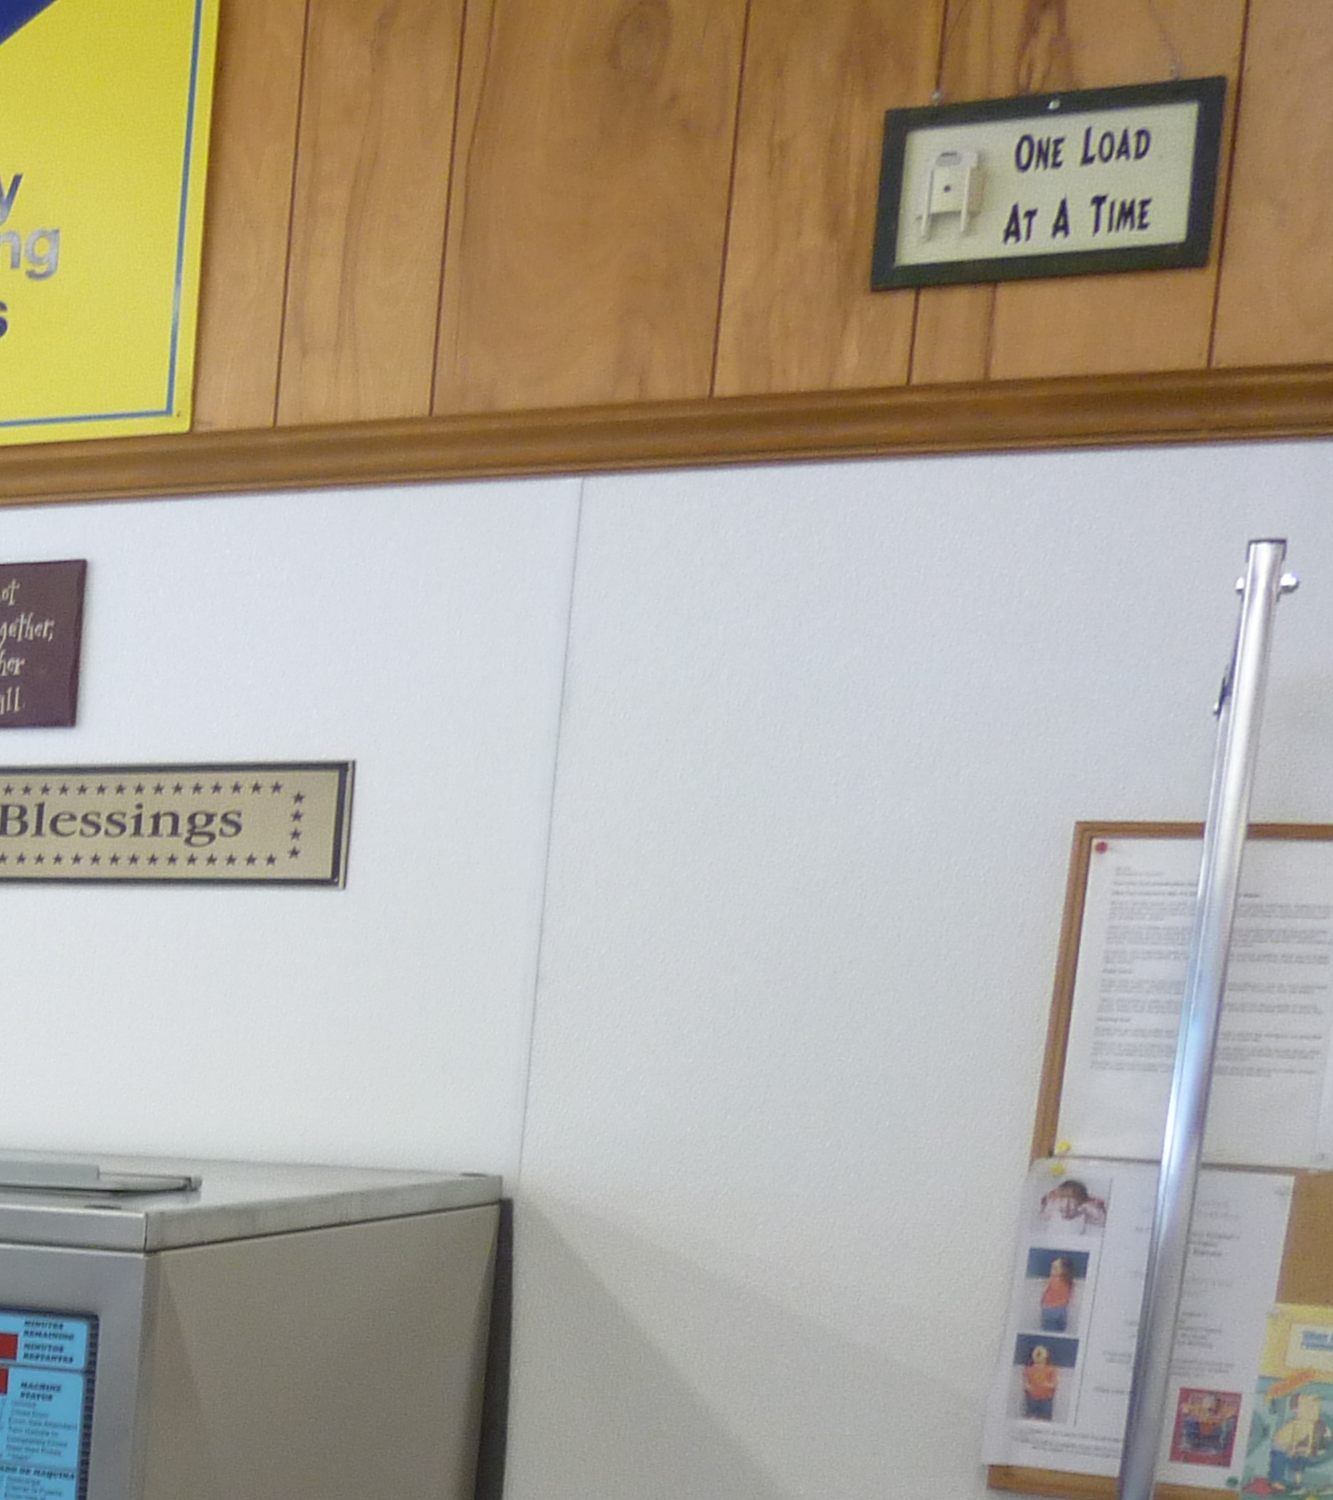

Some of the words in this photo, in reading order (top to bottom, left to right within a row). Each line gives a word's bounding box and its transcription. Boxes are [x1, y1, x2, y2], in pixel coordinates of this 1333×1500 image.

[1015, 134, 1065, 173] ONE
[1080, 126, 1152, 167] LOAD
[1004, 203, 1038, 245] AT
[1051, 198, 1070, 240] A
[1091, 194, 1152, 237] TIME
